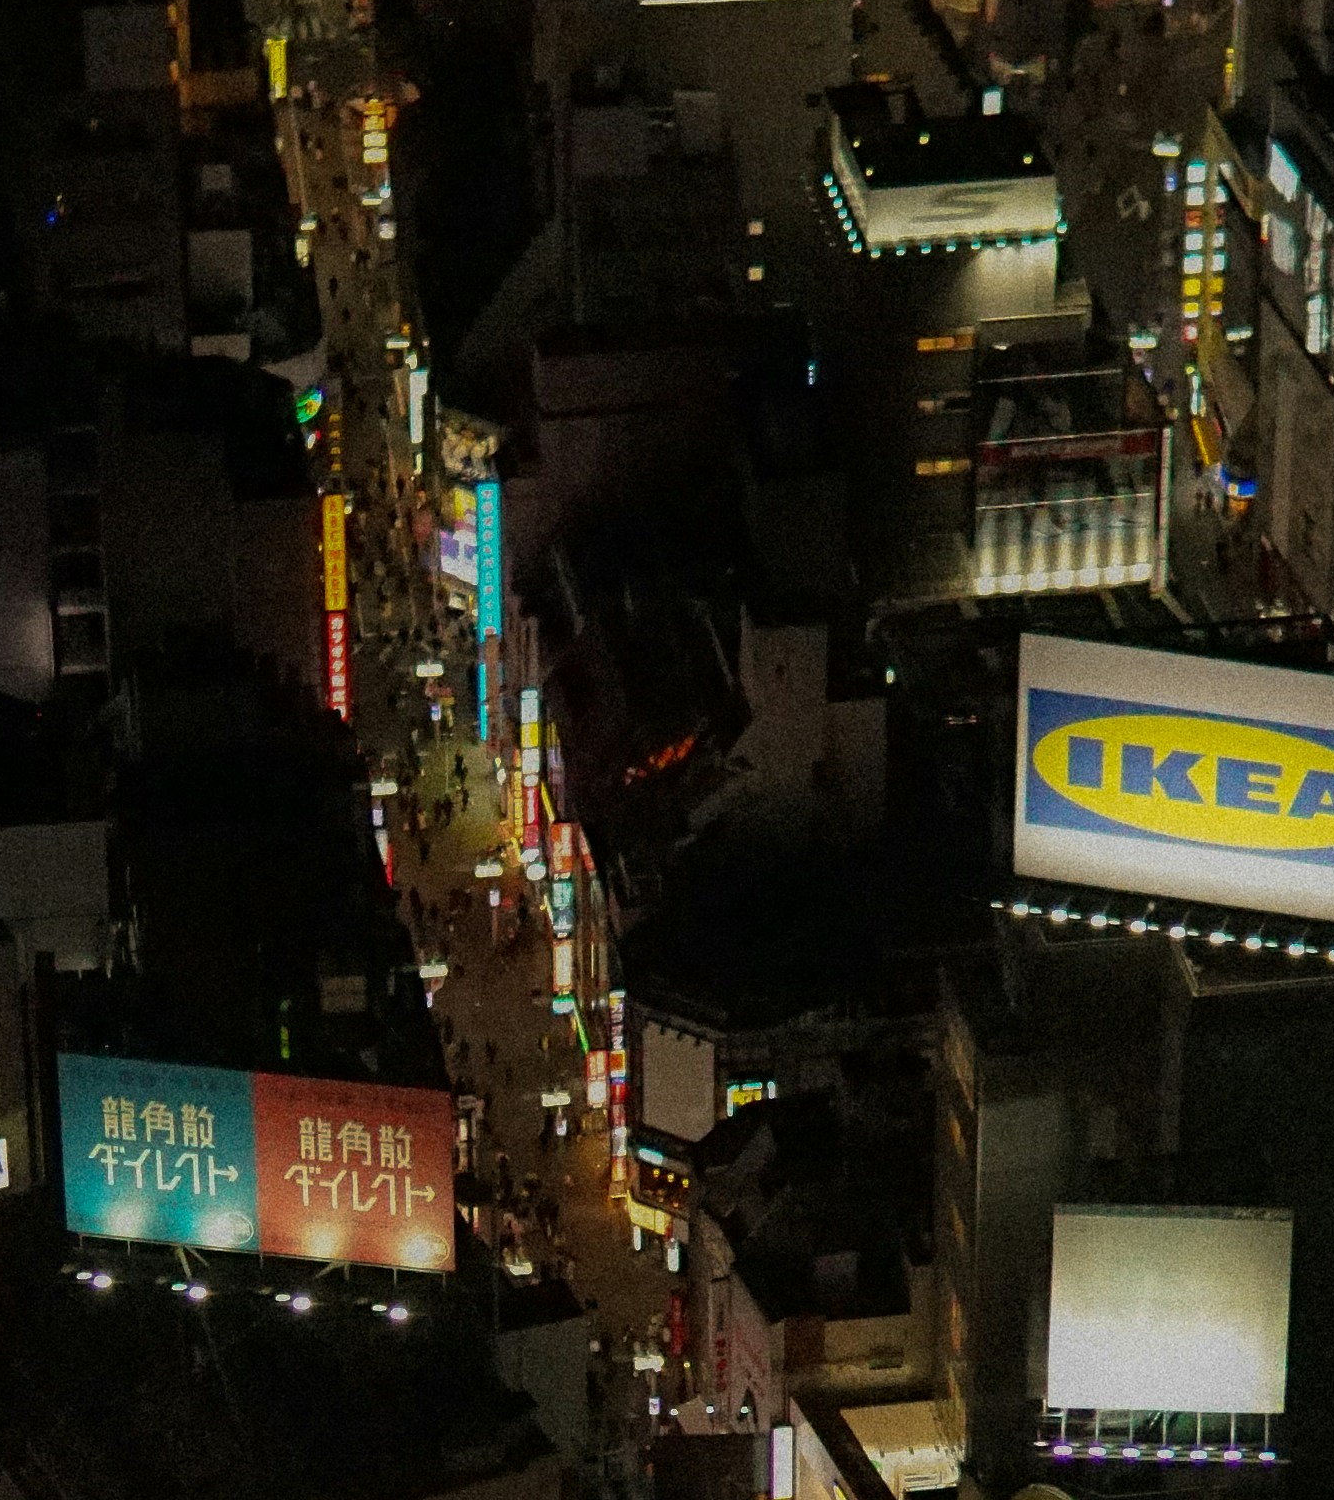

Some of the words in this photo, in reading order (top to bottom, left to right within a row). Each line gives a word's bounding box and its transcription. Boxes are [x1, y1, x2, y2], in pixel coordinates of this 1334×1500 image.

[102, 1096, 216, 1149] 龍角散
[298, 1116, 414, 1170] 龍角散
[88, 1143, 239, 1197] ダイレクト
[283, 1163, 435, 1216] ダイレクト
